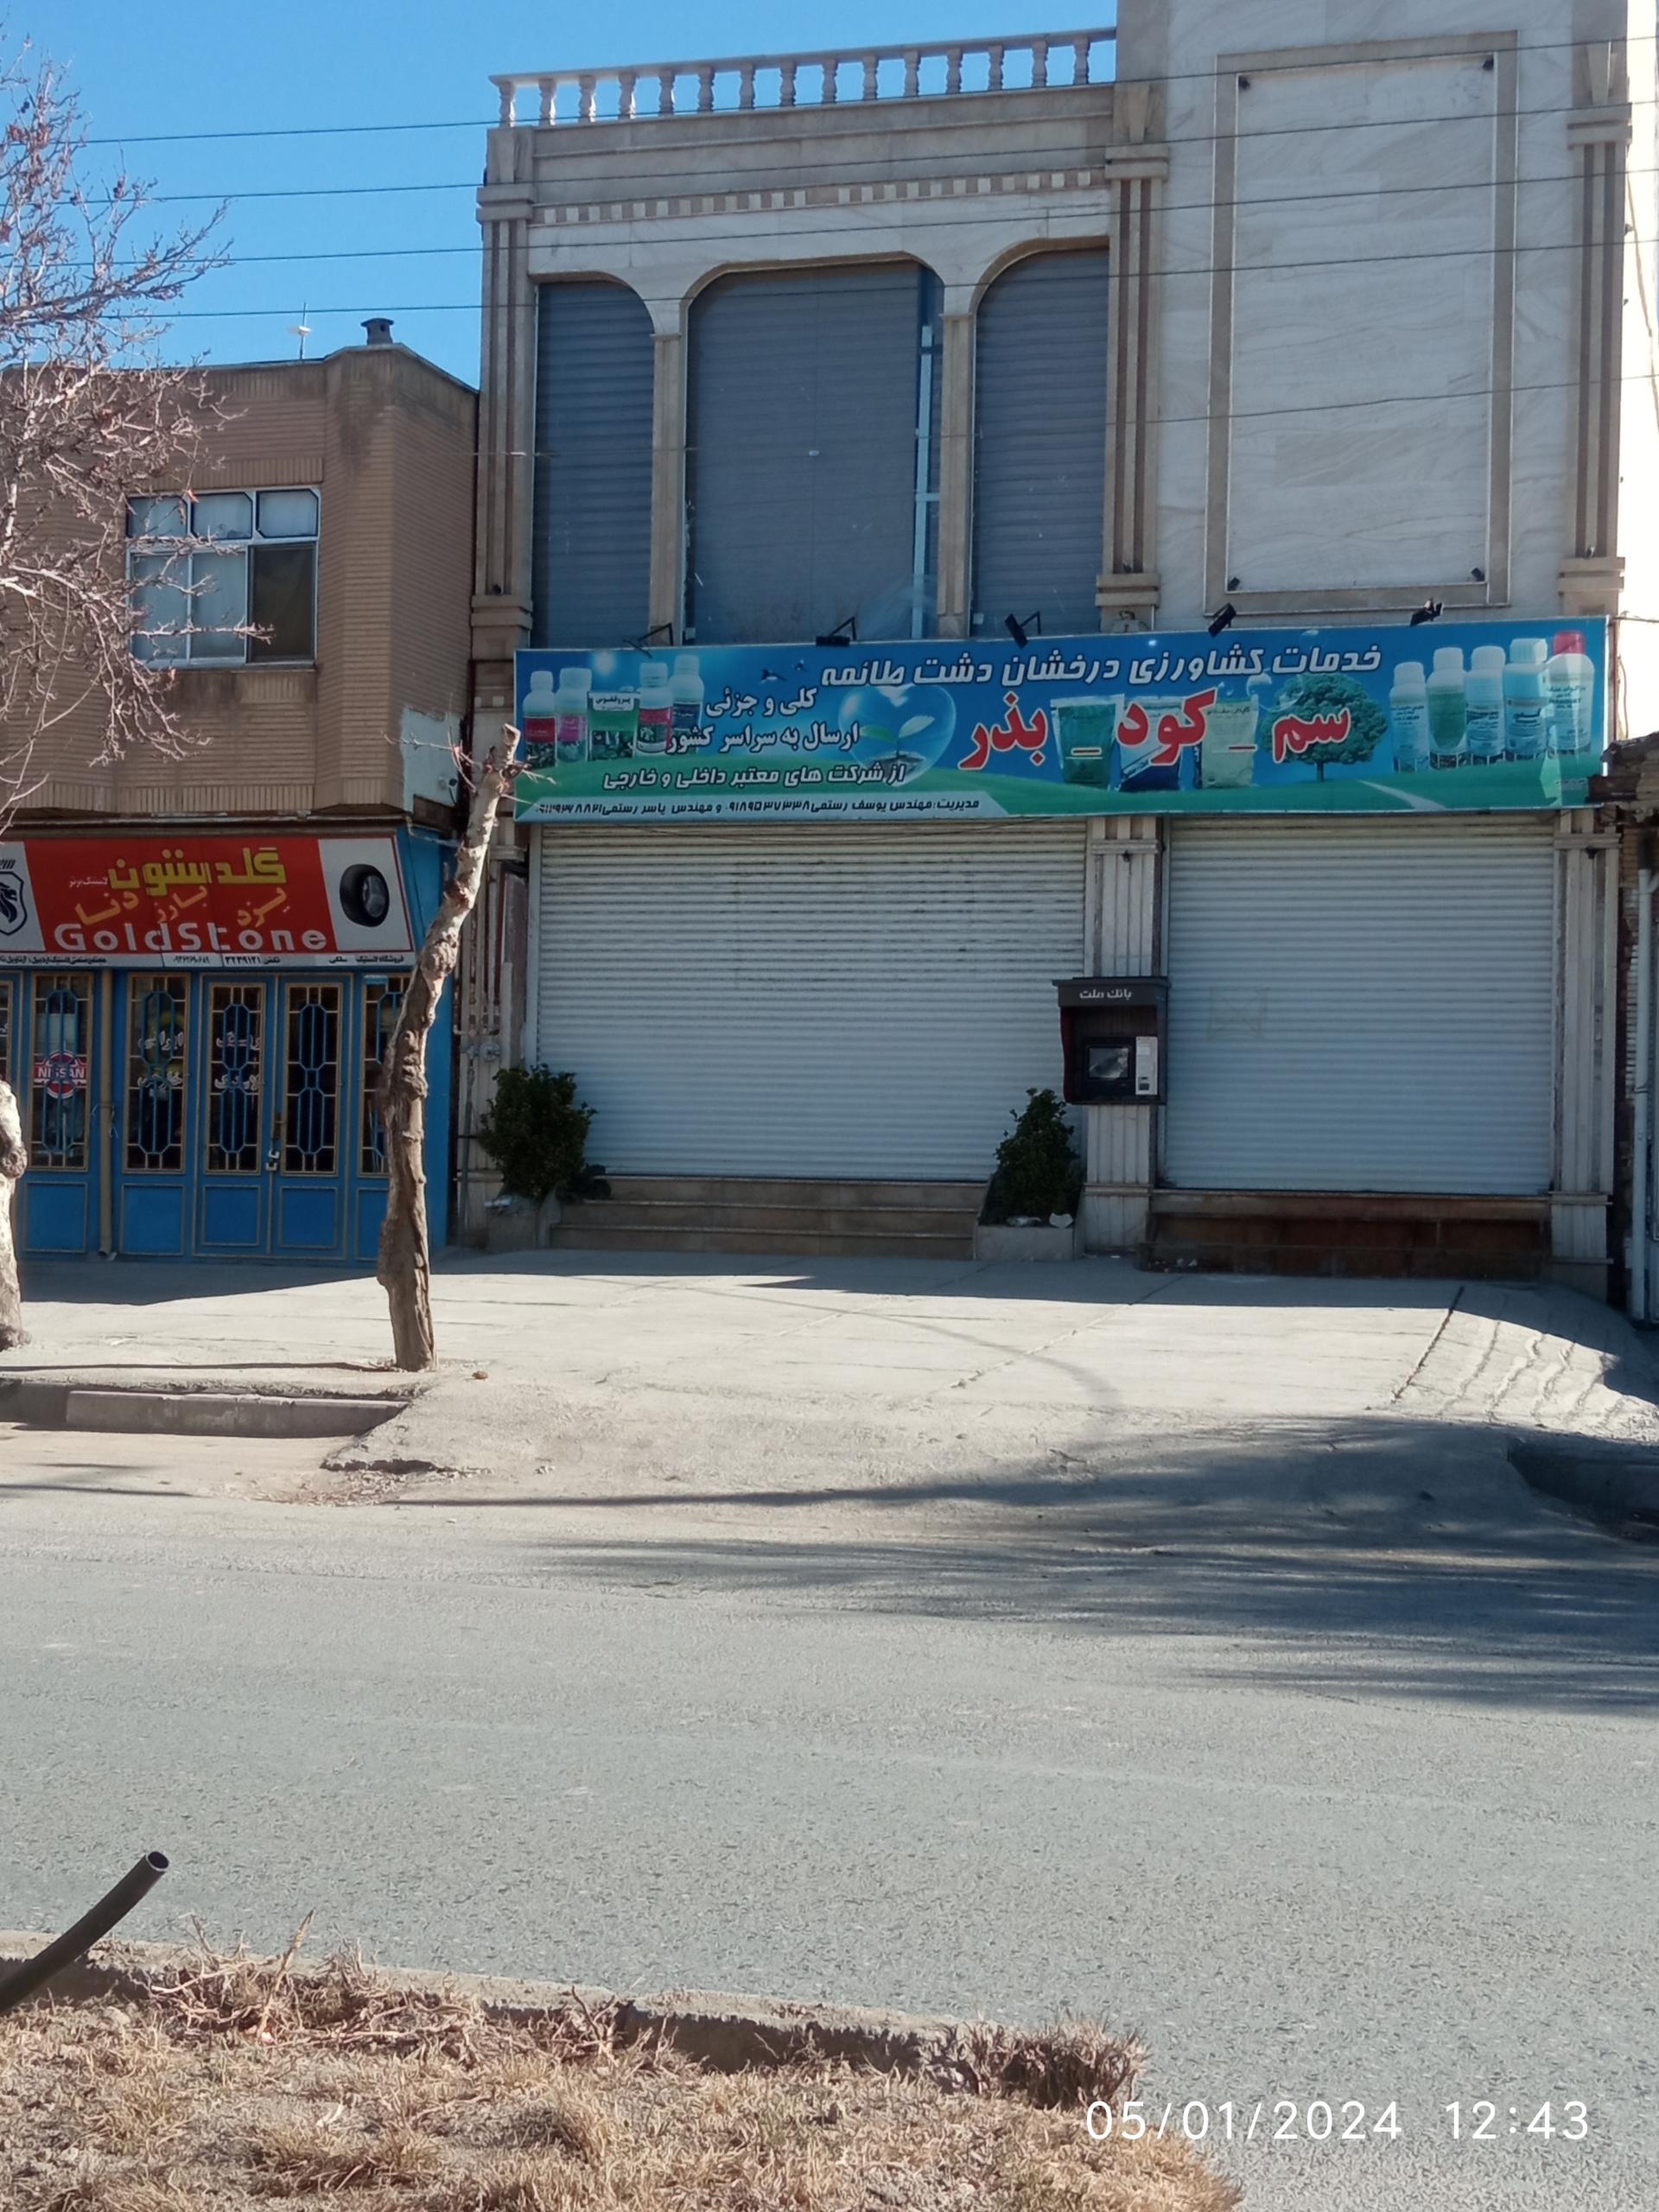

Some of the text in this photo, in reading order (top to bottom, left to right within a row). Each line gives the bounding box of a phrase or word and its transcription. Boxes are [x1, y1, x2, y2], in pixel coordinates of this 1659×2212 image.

[822, 644, 1382, 687] خدمات کشاورزی درخشان دشت طائمه
[705, 688, 760, 718] جزئی
[763, 702, 775, 719] و
[779, 688, 818, 714] کلی
[666, 721, 861, 756] ارسال به سراسر کشور
[958, 688, 1352, 772] سم کود بذر
[602, 761, 906, 791] از شرکت های معتبر داخلی و خارجی
[640, 803, 666, 815] یاسر
[671, 802, 713, 815] مهندس
[715, 804, 721, 814] و
[851, 798, 887, 812] یوسف
[75, 891, 140, 926] دنا
[238, 887, 291, 928] یزد
[54, 922, 327, 951] GoldStone
[1079, 988, 1132, 1001] بانک ملت
[38, 1067, 85, 1078] NISSAN
